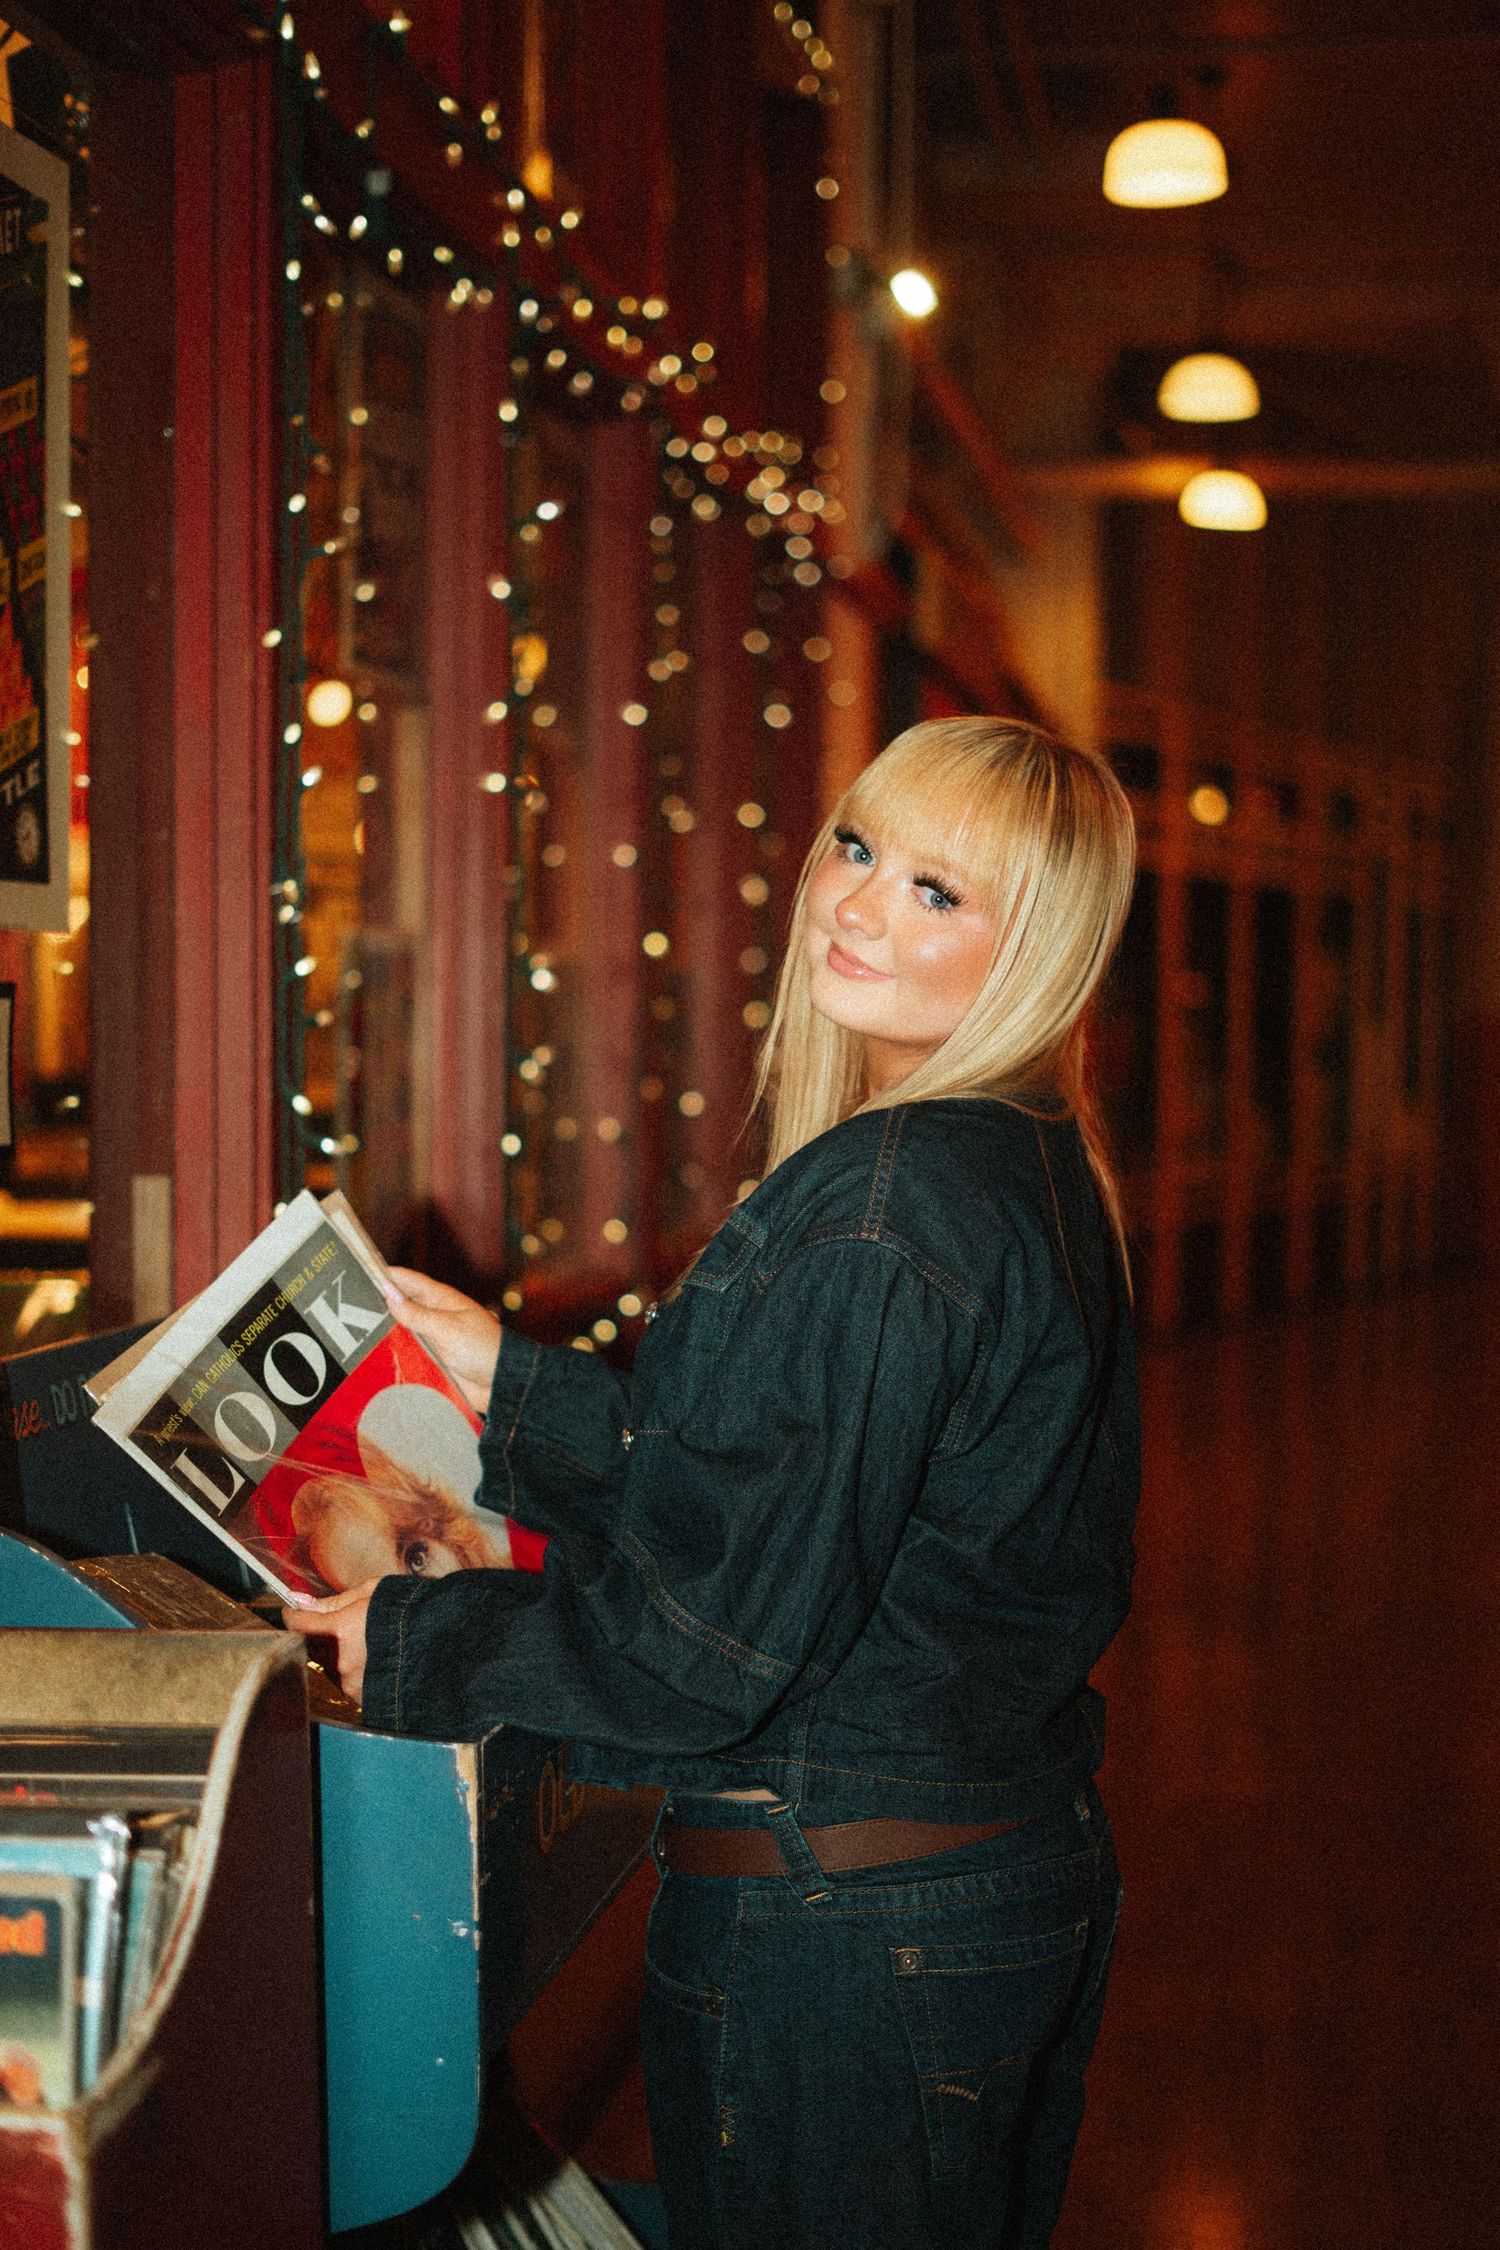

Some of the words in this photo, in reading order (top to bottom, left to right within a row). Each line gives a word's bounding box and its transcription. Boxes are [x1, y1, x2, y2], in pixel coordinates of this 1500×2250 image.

[150, 1432, 164, 1447] A
[160, 1413, 183, 1442] priest's
[191, 1378, 210, 1400] CAN
[205, 1339, 246, 1384] CATHOLICS
[241, 1303, 279, 1346] SEPARATE
[274, 1273, 307, 1311] CHURCH
[303, 1266, 315, 1281] &
[170, 1269, 391, 1517] LOOK
